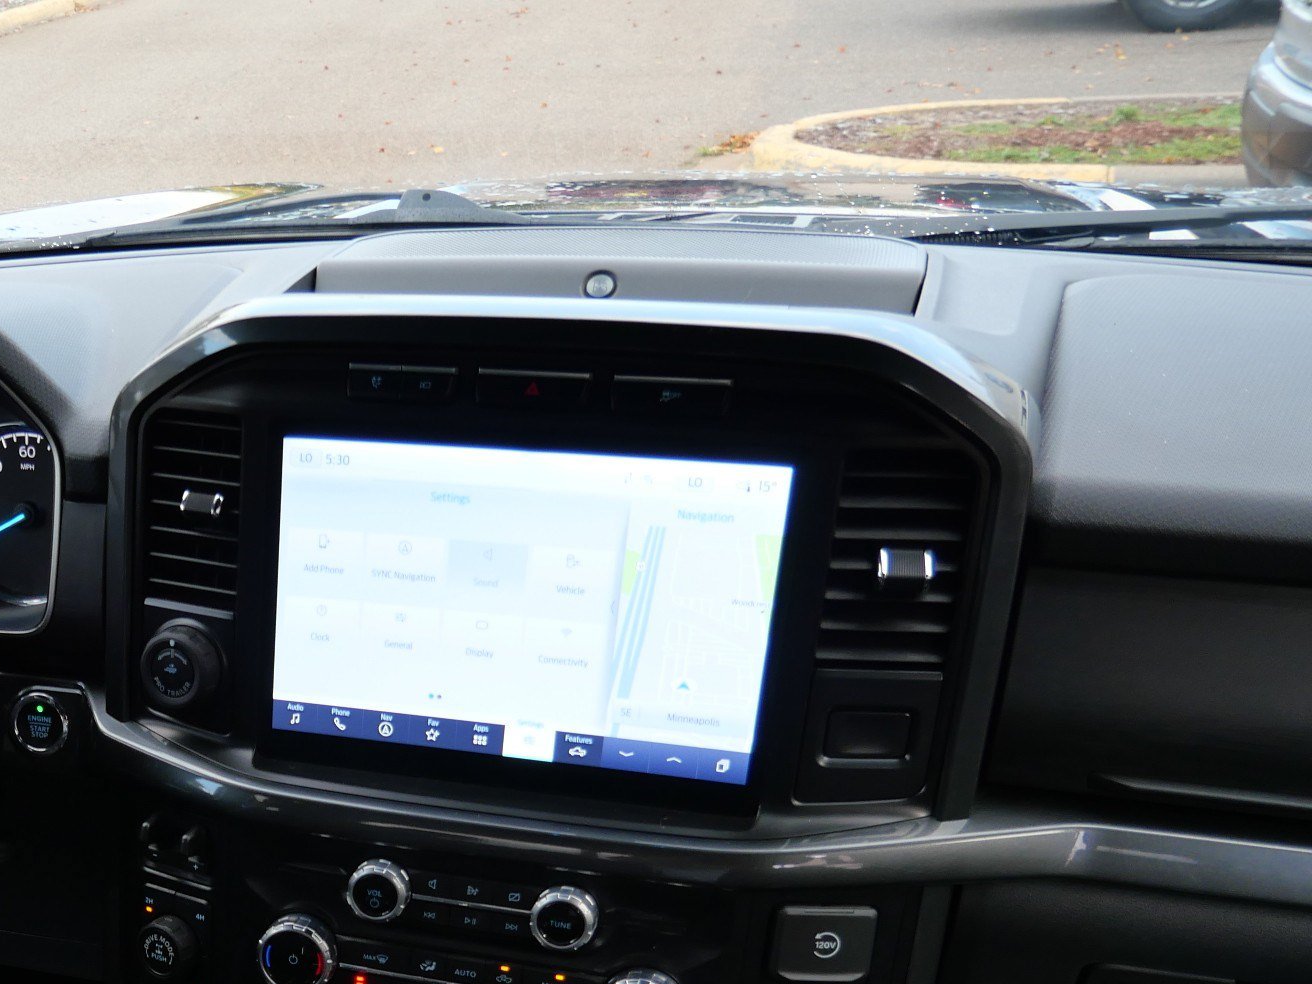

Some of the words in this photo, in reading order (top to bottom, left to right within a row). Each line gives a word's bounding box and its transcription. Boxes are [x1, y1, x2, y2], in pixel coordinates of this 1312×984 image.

[18, 446, 36, 458] 60
[299, 453, 313, 464] LO
[325, 454, 350, 466] 5:30
[20, 463, 35, 471] MPH
[688, 476, 703, 488] LO
[429, 491, 471, 506] Settings
[676, 508, 735, 524] Navigation
[303, 563, 319, 574] Add
[320, 564, 344, 576] Phone
[371, 568, 393, 580] SYNC
[394, 571, 436, 584] Navigation
[473, 577, 499, 589] Sound
[556, 584, 586, 597] Vehicle
[310, 631, 330, 643] Clock
[384, 639, 413, 651] General
[465, 647, 494, 660] Display
[537, 654, 589, 670] Connectivity
[287, 702, 304, 712] Audio
[331, 707, 350, 717] Phone
[28, 714, 52, 724] ENGINE
[380, 713, 393, 722] Nav
[428, 718, 440, 728] Fav
[666, 711, 721, 729] Minneapolis
[30, 724, 50, 733] START
[473, 724, 489, 734] Apps
[31, 731, 48, 739] STOP
[565, 734, 593, 745] Features
[367, 888, 382, 898] VOL
[195, 912, 205, 922] 4H
[549, 919, 573, 931] TUNE
[815, 941, 837, 950] 120V
[151, 952, 167, 963] PUSH
[454, 967, 477, 979] AUTO
